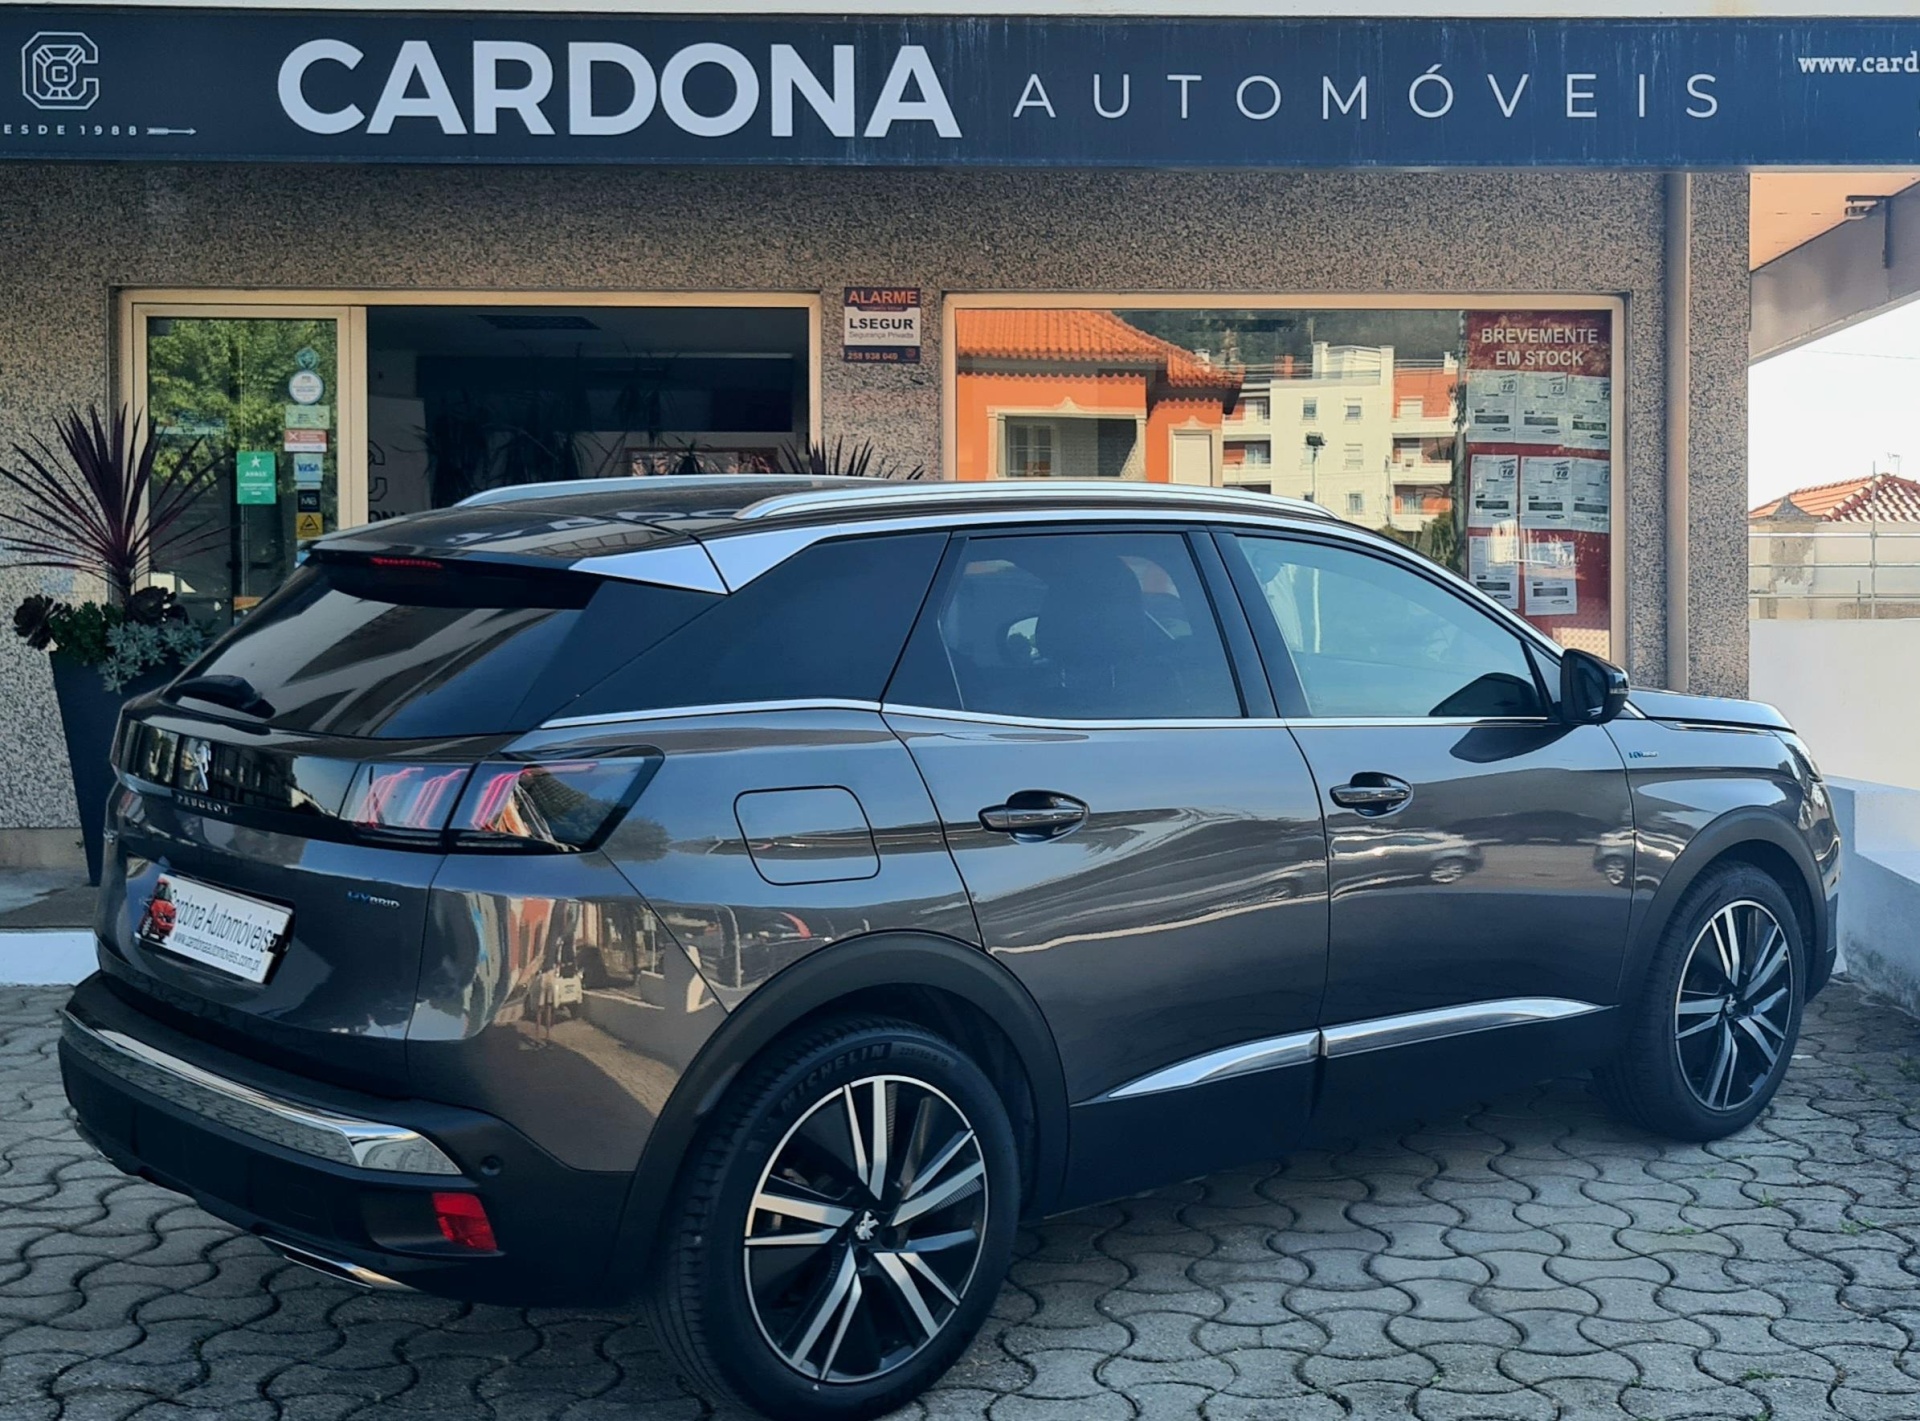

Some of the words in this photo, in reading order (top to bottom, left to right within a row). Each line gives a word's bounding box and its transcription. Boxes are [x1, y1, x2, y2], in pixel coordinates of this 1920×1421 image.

[1798, 50, 1920, 74] www.card
[277, 38, 963, 138] CARDONA
[1012, 63, 1719, 120] AUTOMÓVEIS
[79, 124, 138, 136] 1988
[847, 290, 918, 304] ALARME
[849, 317, 914, 330] LSEGUR
[1480, 327, 1599, 344] BREVEMENTE
[1495, 350, 1520, 366] EM
[1525, 350, 1584, 366] STOCK
[297, 463, 320, 472] VISA
[177, 794, 230, 815] PEUGEOT
[203, 901, 274, 954] Automóveis
[780, 1043, 886, 1113] MICHELIN
